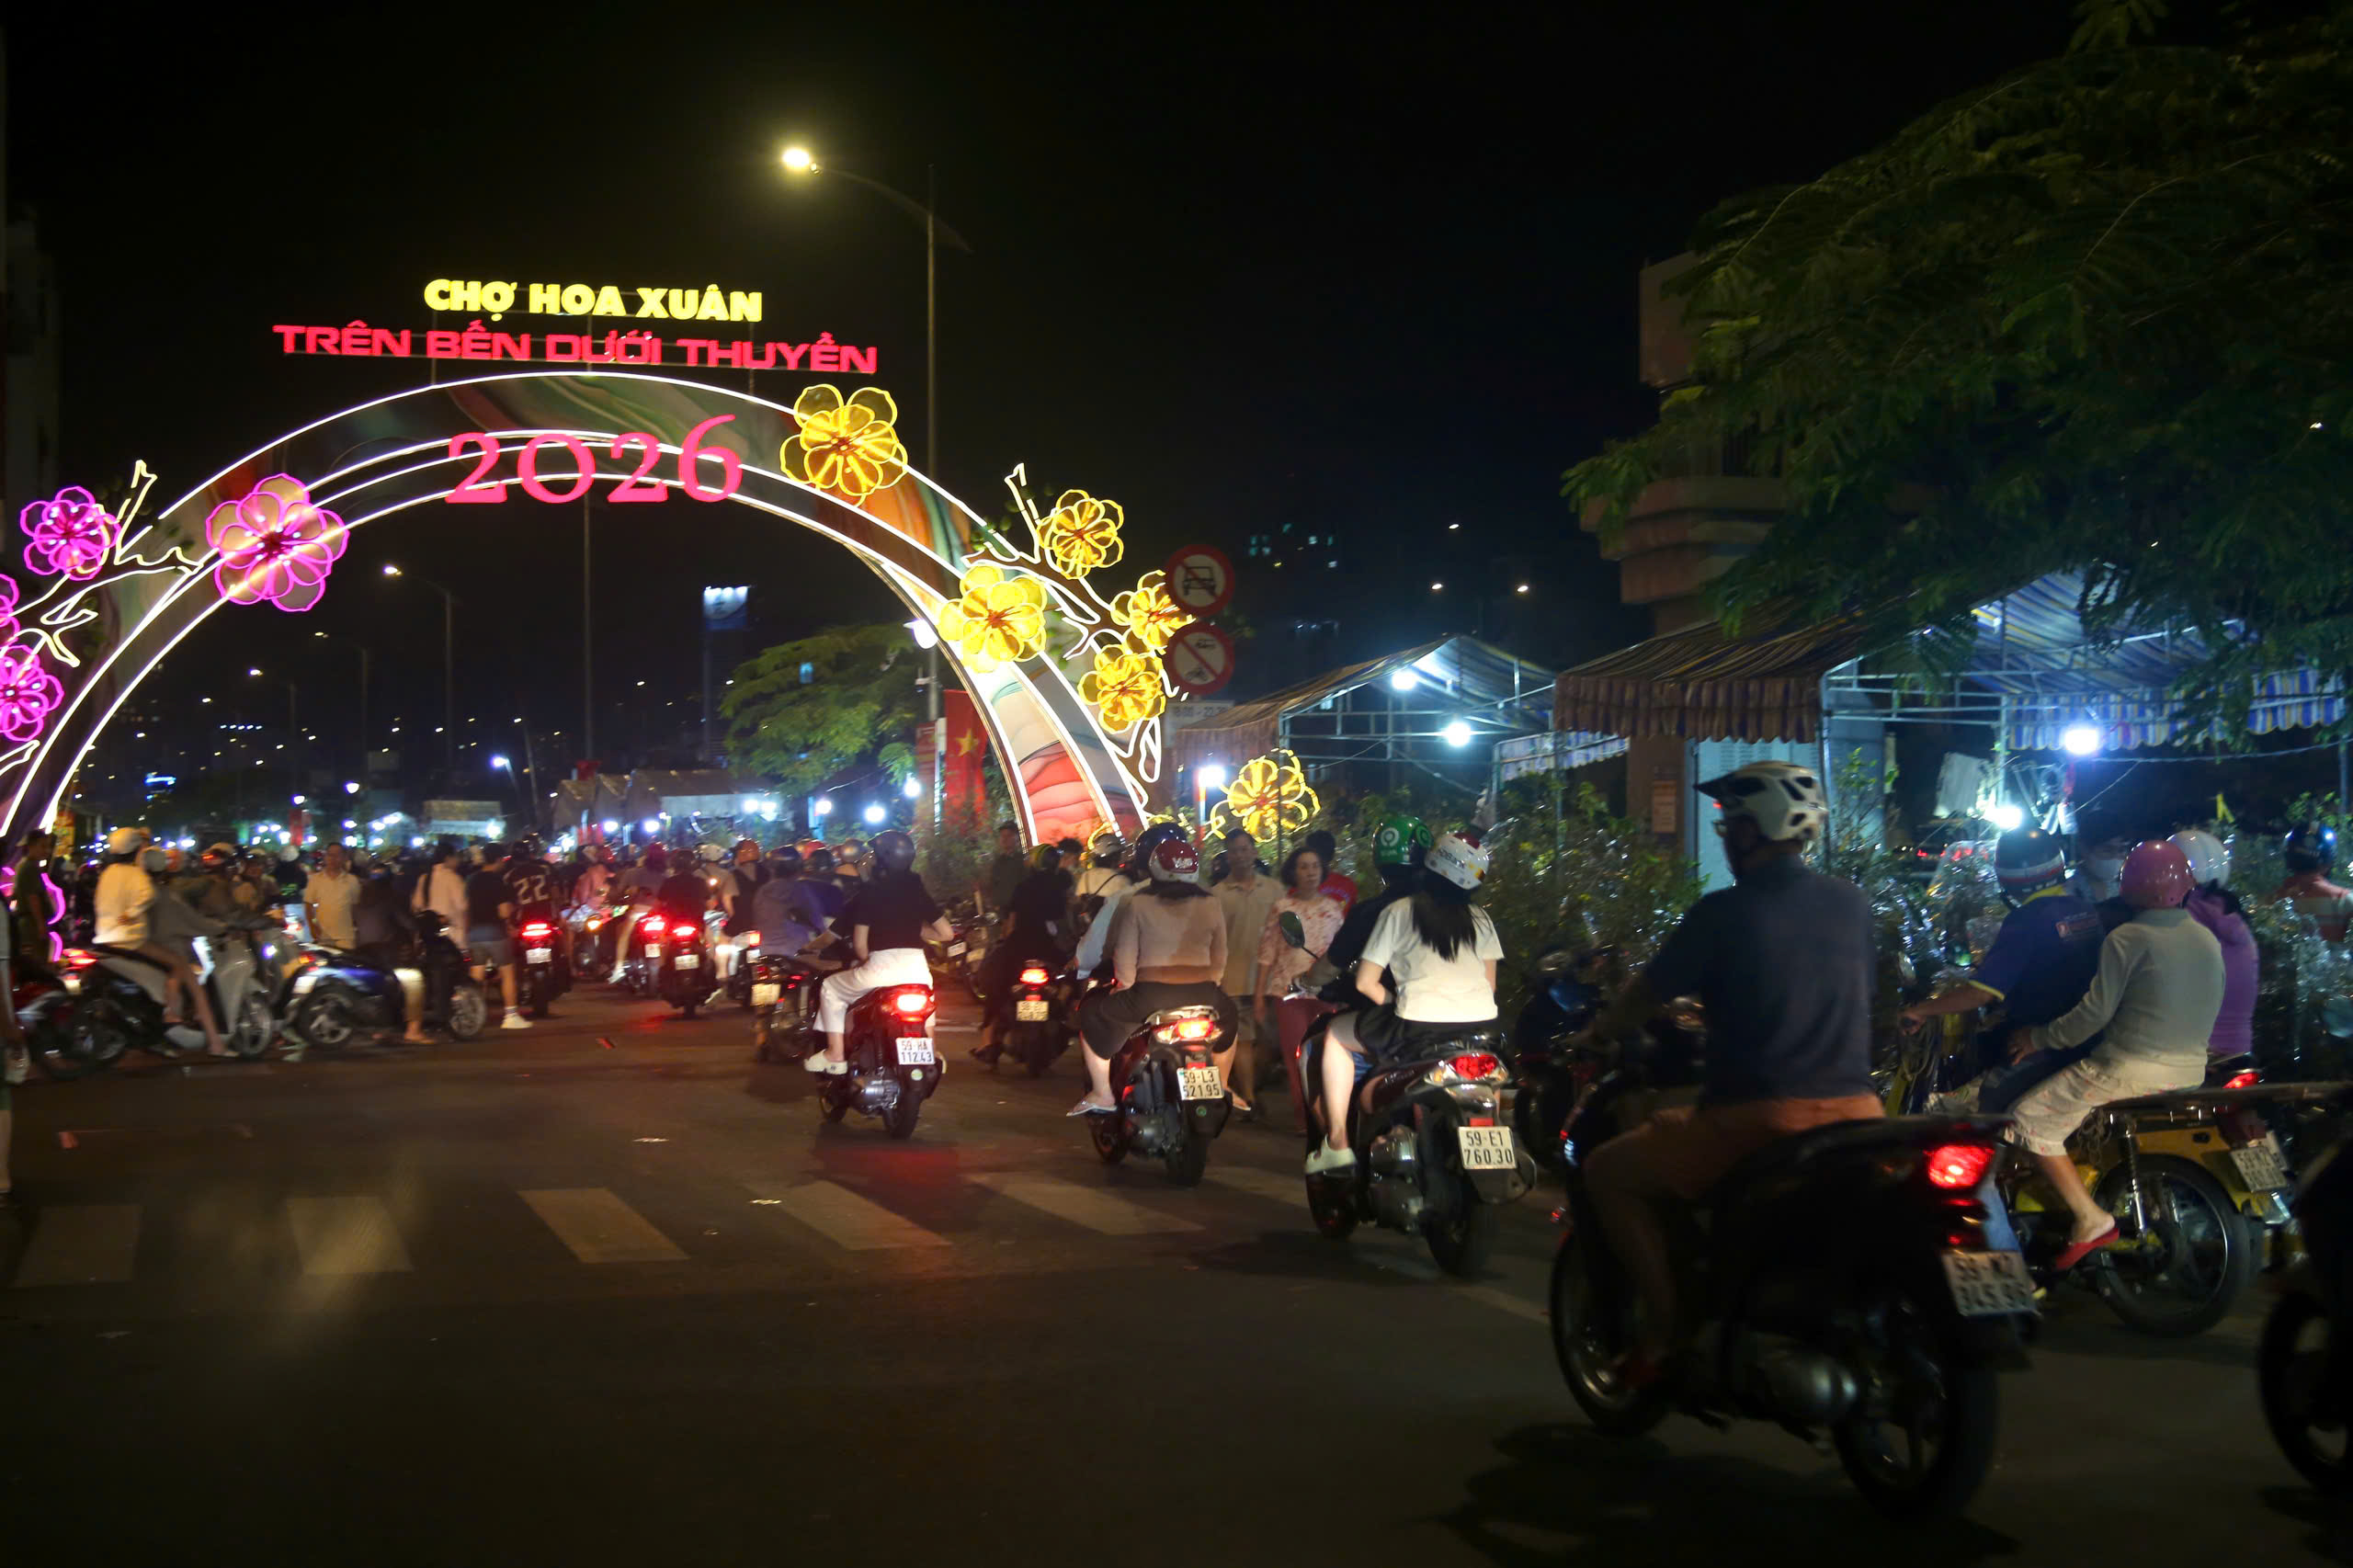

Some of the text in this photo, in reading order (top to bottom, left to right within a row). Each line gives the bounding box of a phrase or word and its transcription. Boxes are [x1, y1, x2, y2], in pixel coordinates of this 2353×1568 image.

[424, 278, 763, 322] CHỢ HOA XUÂN
[273, 320, 878, 374] TRÊN BẾN DƯỚI THUYỀN
[445, 414, 744, 504] 2026
[514, 874, 550, 905] 22
[1183, 1070, 1215, 1085] 59-L3
[1465, 1131, 1504, 1147] 59-E1
[1463, 1147, 1514, 1165] 760.30
